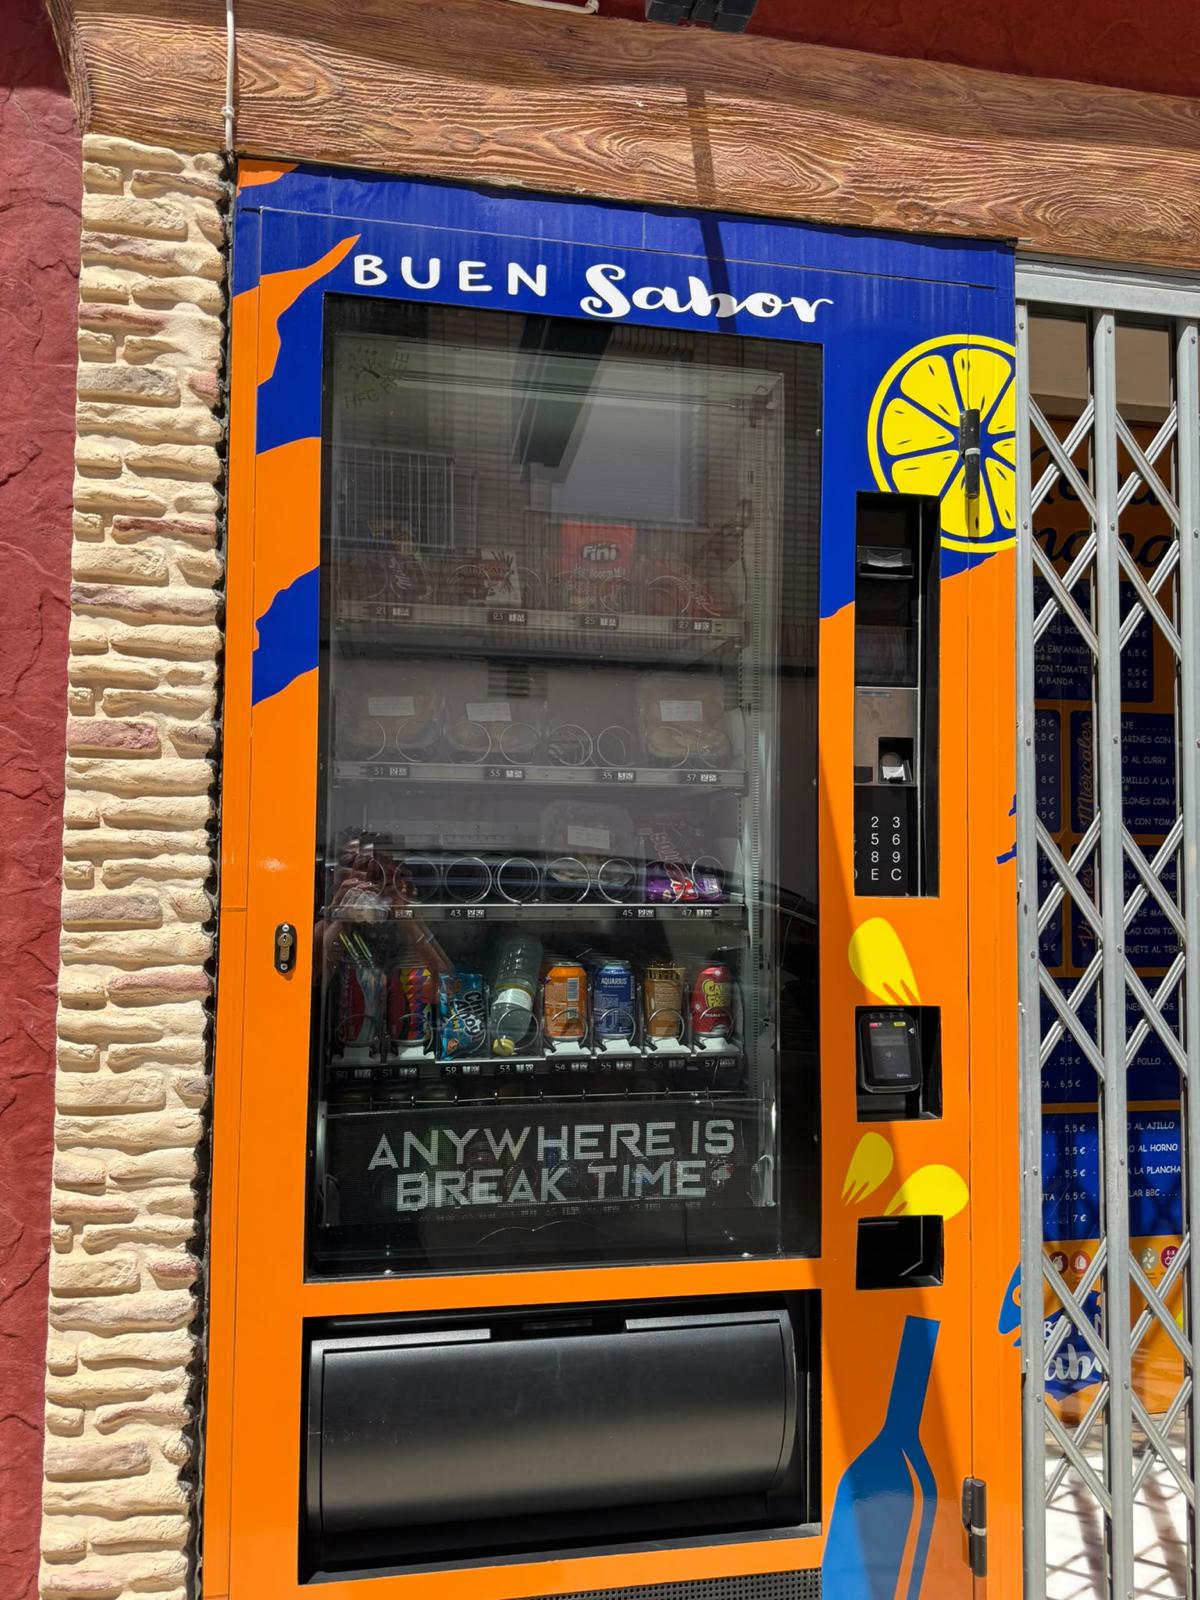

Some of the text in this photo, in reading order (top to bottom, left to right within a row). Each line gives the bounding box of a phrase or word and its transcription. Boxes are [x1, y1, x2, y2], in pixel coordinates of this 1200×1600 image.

[353, 253, 835, 325] BUEN Sabor
[1036, 664, 1053, 674] CON
[1055, 664, 1089, 675] TOMATE
[1143, 756, 1168, 765] CURRY
[871, 816, 901, 828] 2 3
[1135, 818, 1153, 827] CON
[1154, 818, 1176, 827] TOMA
[871, 833, 901, 846] 5 6
[871, 851, 901, 863] 8 9
[871, 868, 902, 881] E C
[1143, 927, 1160, 936] CON
[1125, 946, 1150, 954] GUETI
[601, 977, 628, 985] AQUARIUS
[1137, 1058, 1161, 1066] POLLO
[1064, 1124, 1086, 1133] 5,5 €
[1134, 1121, 1175, 1130] AL AJILLO
[367, 1119, 735, 1171] ANYWHERE IS
[1137, 1143, 1178, 1153] AL HORNO
[1064, 1146, 1086, 1156] 5,5 €
[1064, 1168, 1086, 1178] 5,5 €
[1134, 1167, 1144, 1175] LA
[1146, 1166, 1182, 1175] PLANCHA
[397, 1160, 707, 1212] BREAK TIME
[1064, 1192, 1078, 1200] 6,5
[1145, 1189, 1160, 1197] BBC
[1080, 1214, 1087, 1222] €
